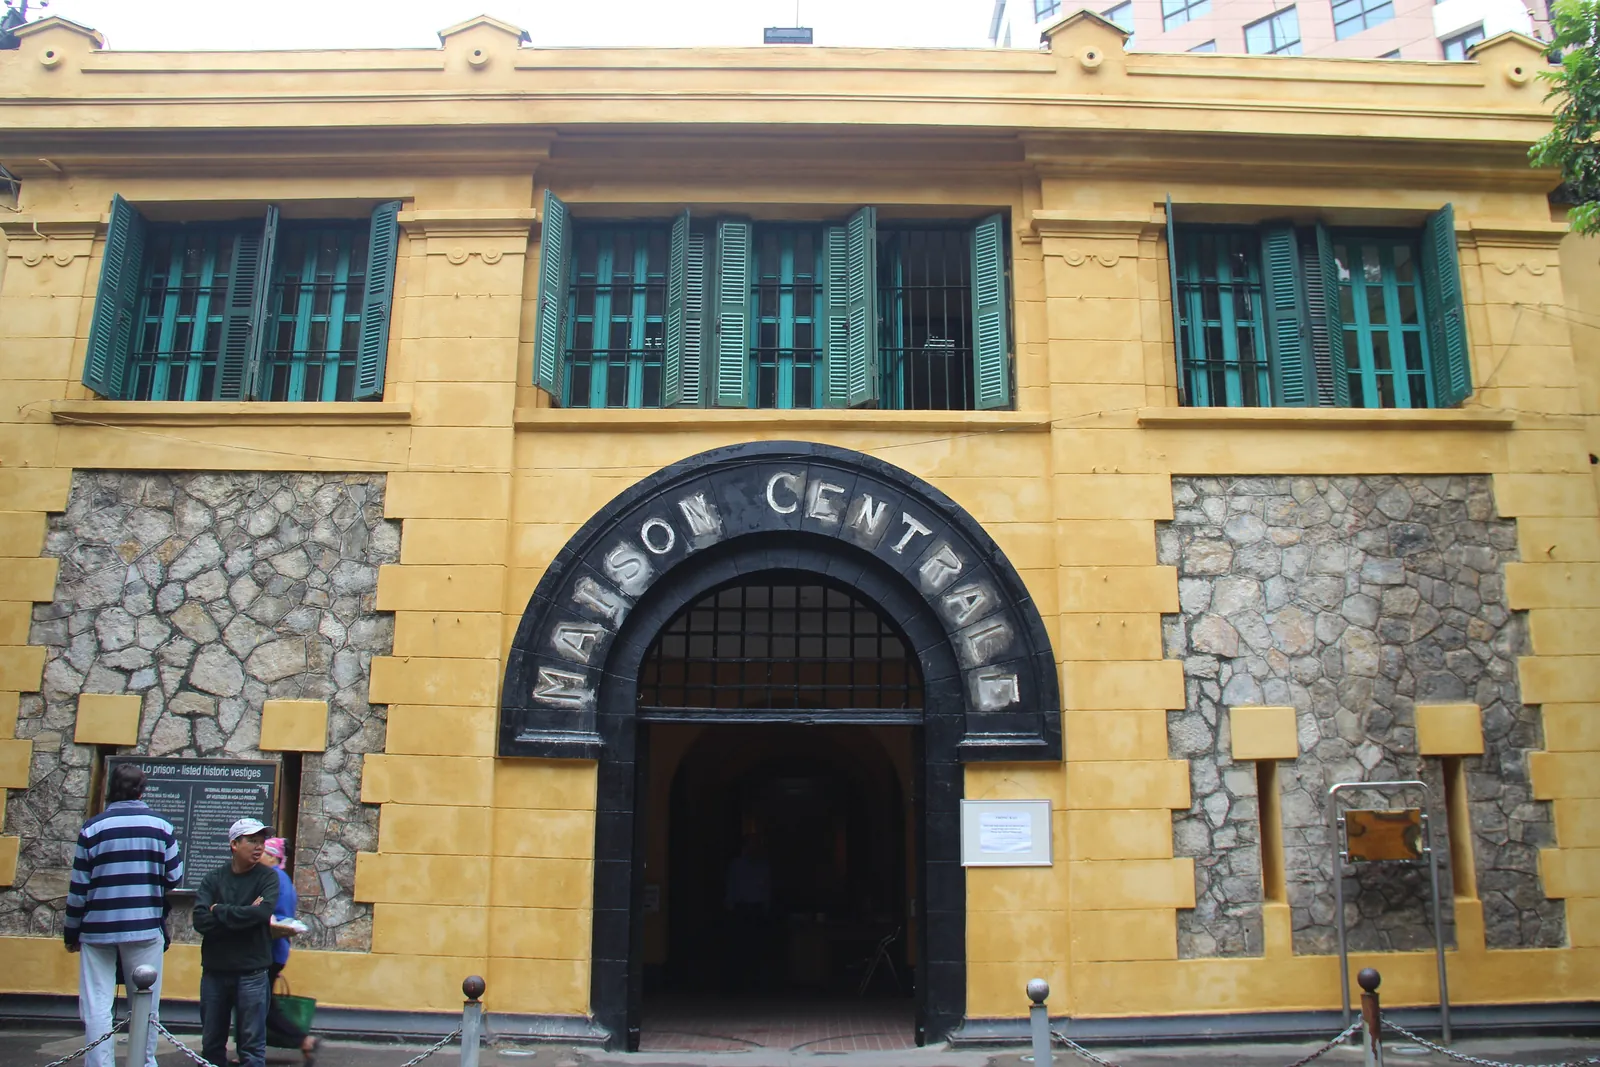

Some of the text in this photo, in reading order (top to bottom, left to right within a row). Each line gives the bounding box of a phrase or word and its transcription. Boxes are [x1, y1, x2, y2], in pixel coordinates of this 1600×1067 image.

[533, 471, 1020, 709] MAISON CENTRALE
[142, 764, 151, 774] Lo
[153, 765, 176, 776] prison
[181, 765, 201, 776] listed
[203, 766, 228, 777] historic
[230, 767, 261, 780] vestiges
